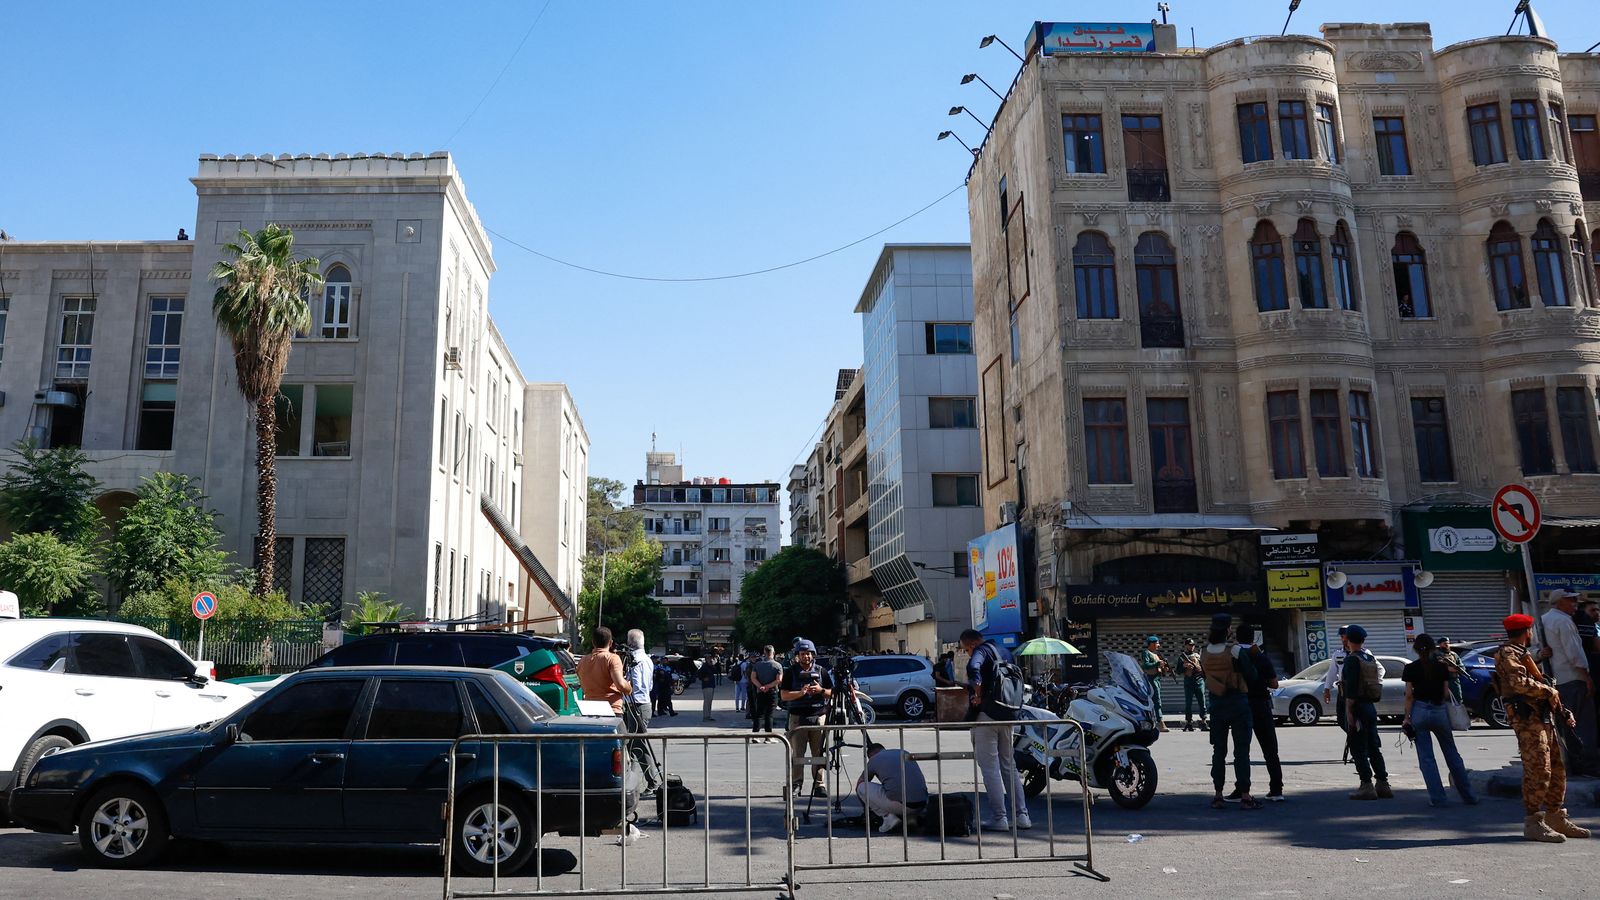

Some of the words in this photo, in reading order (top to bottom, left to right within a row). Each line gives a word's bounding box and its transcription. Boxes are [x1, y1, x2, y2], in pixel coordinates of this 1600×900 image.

[997, 546, 1015, 580] 10%
[1072, 593, 1106, 604] Dahabi
[1107, 593, 1142, 607] Optical
